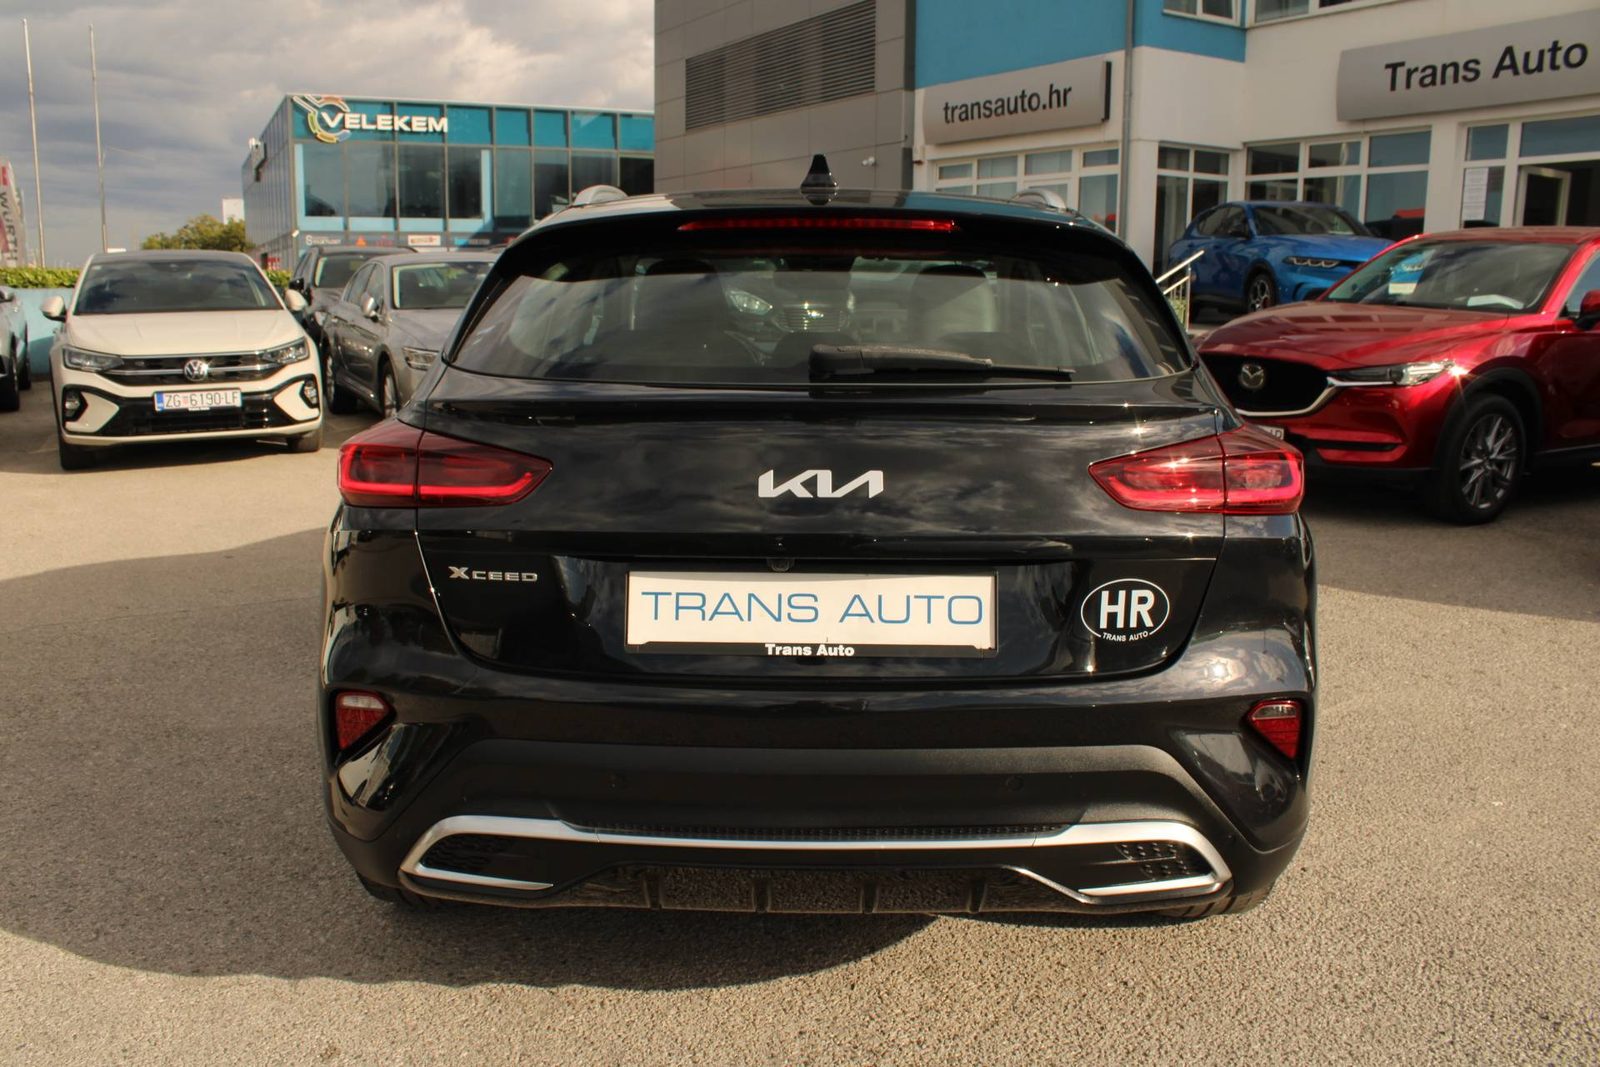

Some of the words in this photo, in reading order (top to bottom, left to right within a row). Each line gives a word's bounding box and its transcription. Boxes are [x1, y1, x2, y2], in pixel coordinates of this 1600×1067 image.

[1384, 58, 1481, 92] Trans
[1492, 40, 1588, 79] Auto
[943, 83, 1072, 124] transauto.hr
[320, 110, 448, 133] VELEKEM
[165, 394, 181, 408] ZG
[641, 591, 819, 623] TRANS
[838, 594, 983, 625] AUTO
[1099, 589, 1155, 629] HR
[765, 643, 812, 656] Trans
[816, 643, 855, 657] Auto
[1102, 632, 1127, 642] TRANS
[1128, 630, 1149, 642] AUTO
